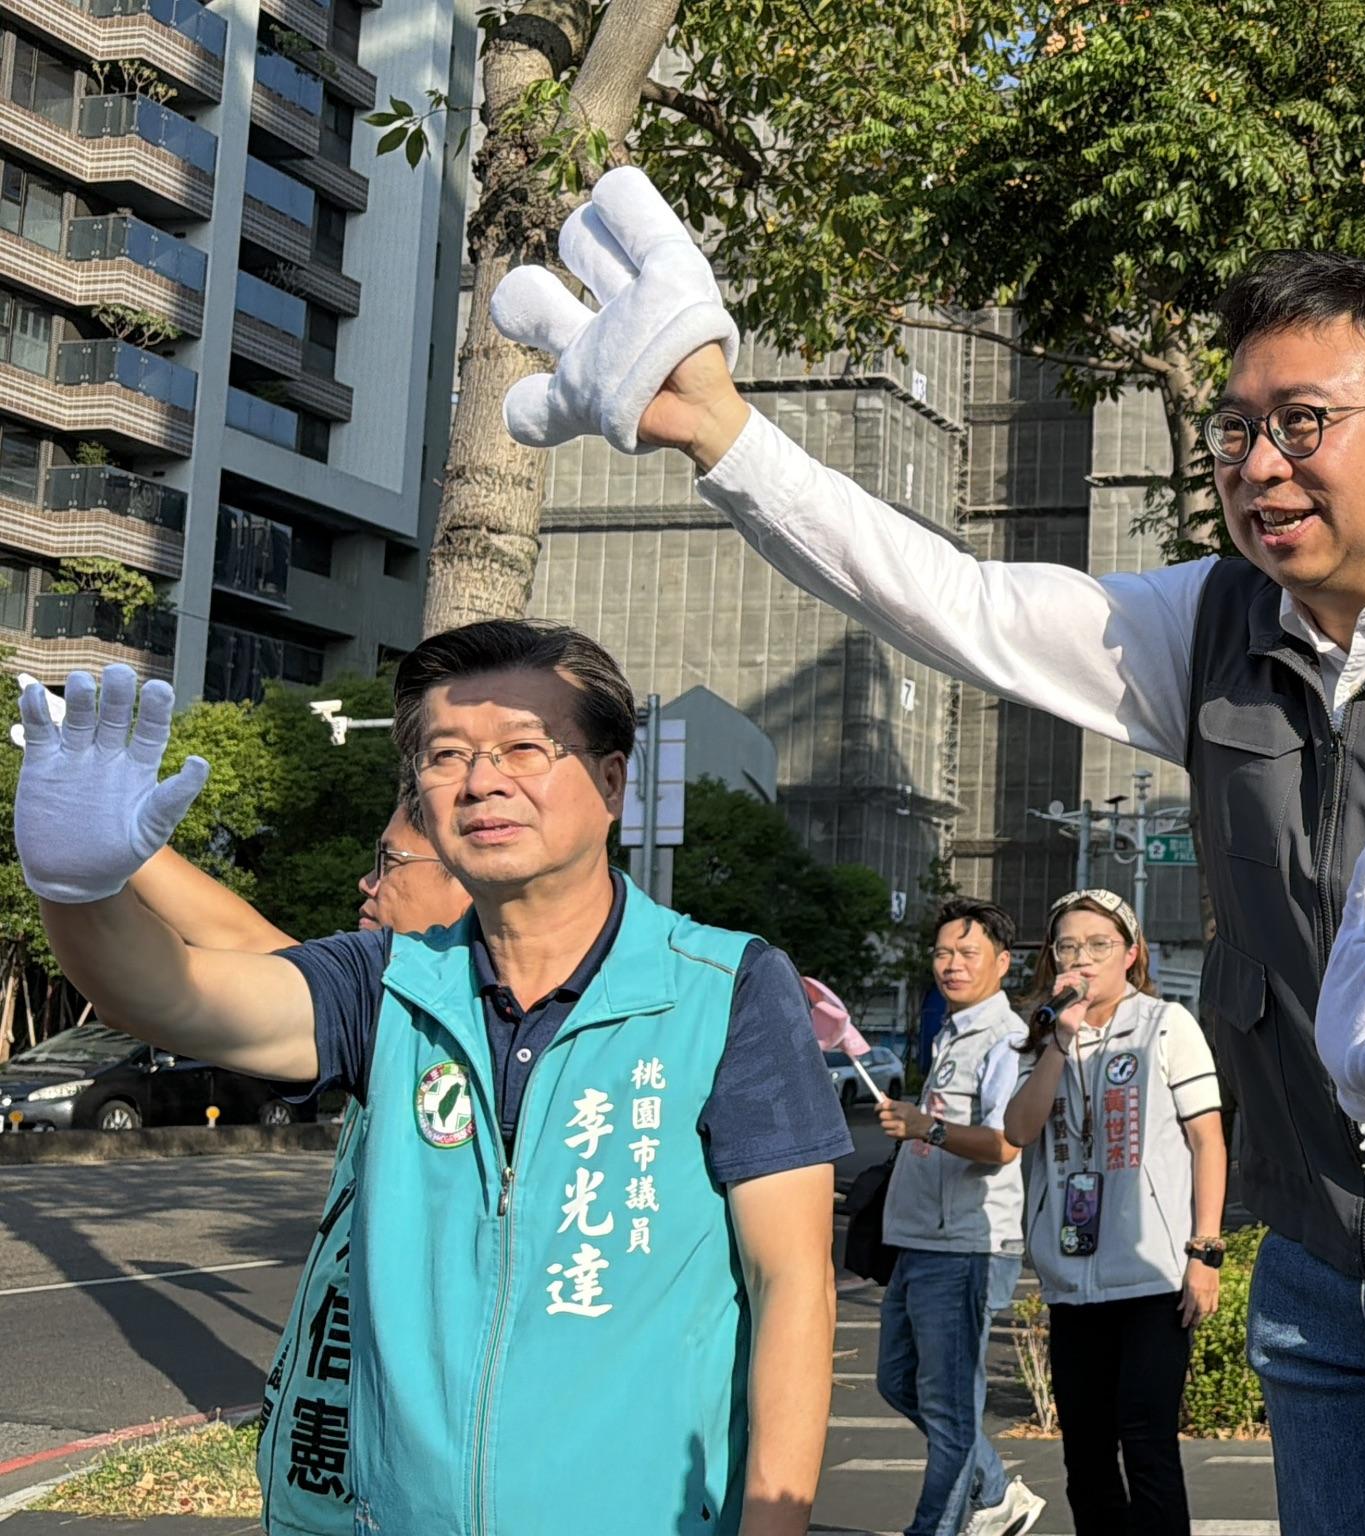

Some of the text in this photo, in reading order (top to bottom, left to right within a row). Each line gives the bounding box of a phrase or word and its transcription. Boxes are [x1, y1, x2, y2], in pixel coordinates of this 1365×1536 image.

[546, 1088, 614, 1317] 李光達
[625, 1057, 666, 1254] 桃園市議員
[1104, 1088, 1125, 1170] 黃世杰
